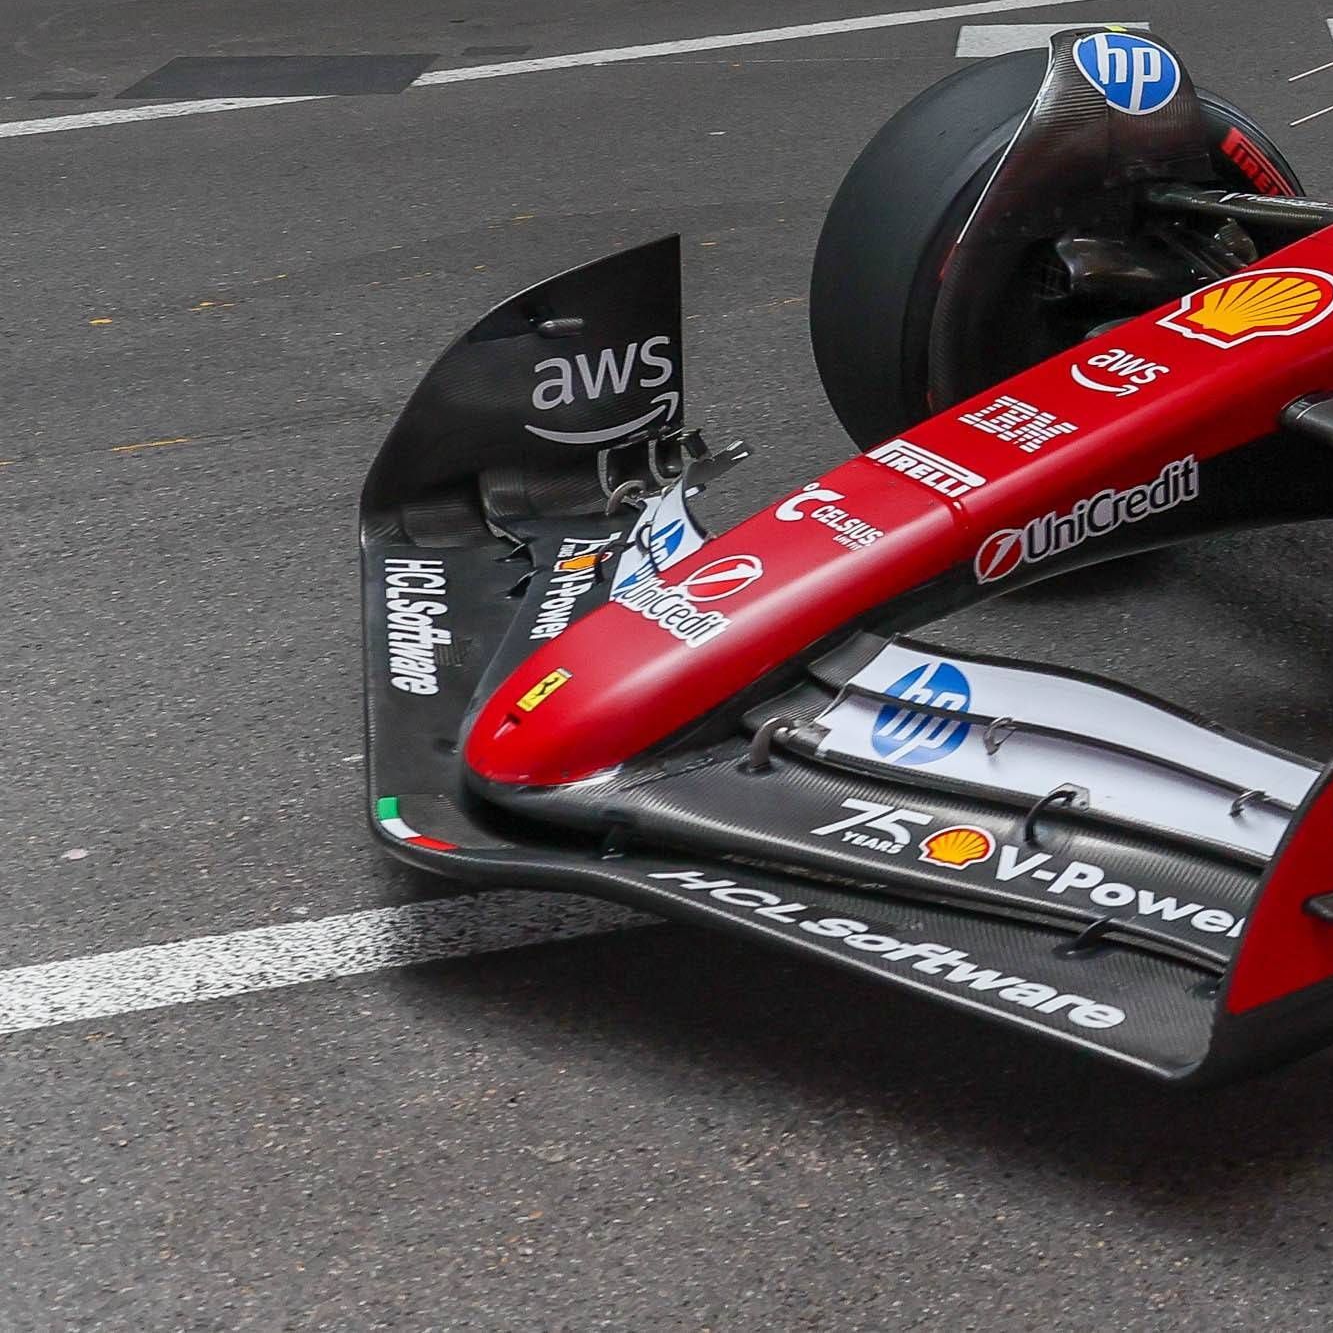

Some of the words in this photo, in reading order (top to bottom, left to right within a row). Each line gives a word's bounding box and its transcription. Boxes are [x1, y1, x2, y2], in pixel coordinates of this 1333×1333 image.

[1094, 33, 1162, 114] hp
[531, 335, 674, 411] aws
[1086, 347, 1171, 386] aws
[957, 395, 1079, 453] IBM
[865, 439, 987, 498] PIRELLI
[811, 505, 885, 547] CELSIUS
[1024, 454, 1199, 563] UniCredit
[618, 568, 732, 648] UniCredit
[881, 662, 966, 764] hp
[811, 797, 934, 848] 75
[843, 830, 905, 855] YEARS
